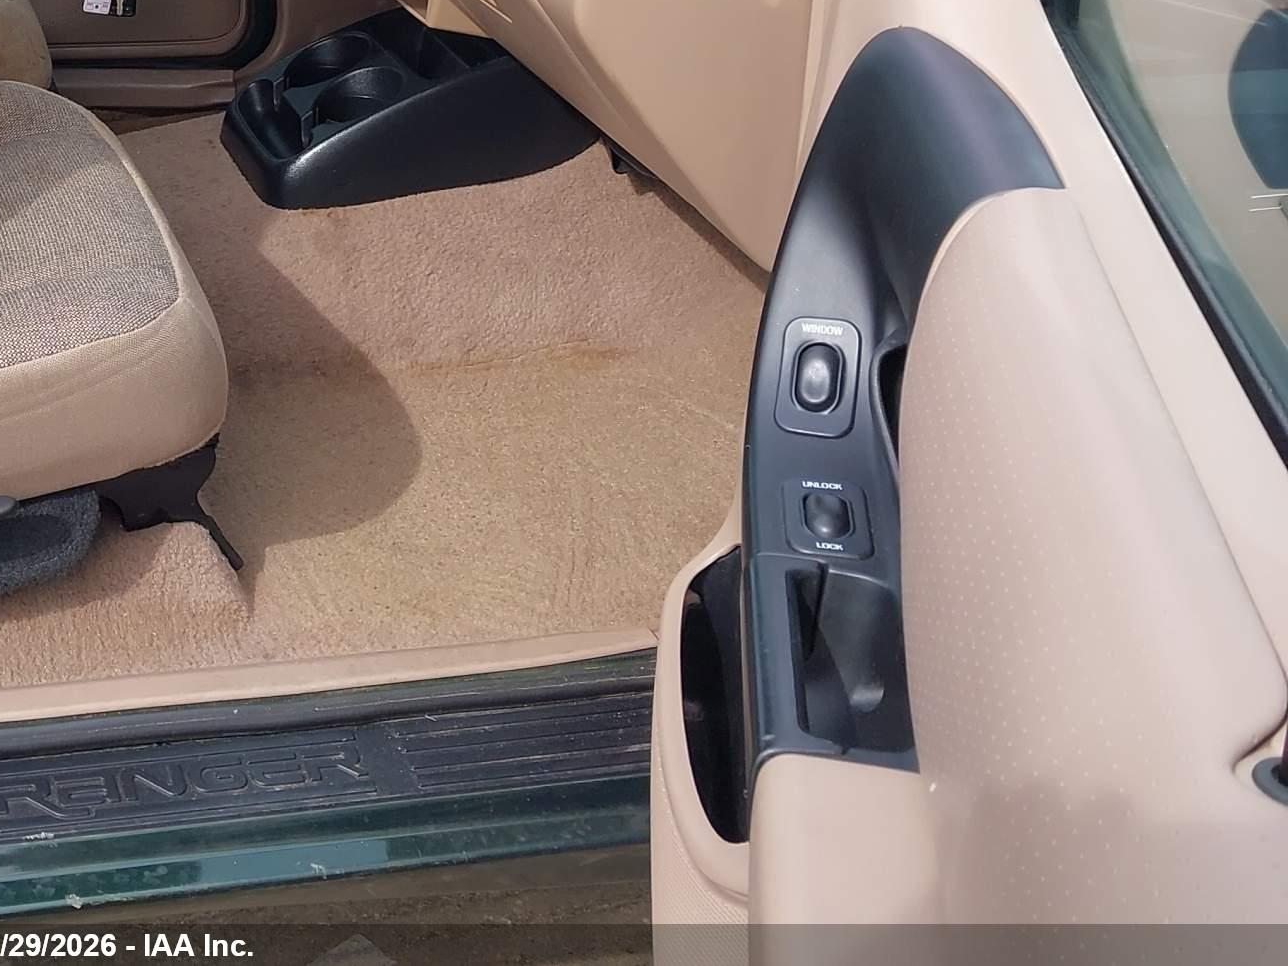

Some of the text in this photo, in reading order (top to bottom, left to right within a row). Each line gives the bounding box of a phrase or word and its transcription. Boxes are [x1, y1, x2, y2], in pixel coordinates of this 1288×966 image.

[801, 322, 843, 336] WINDOW
[802, 480, 843, 491] UNLOCK
[815, 541, 844, 551] LOCK
